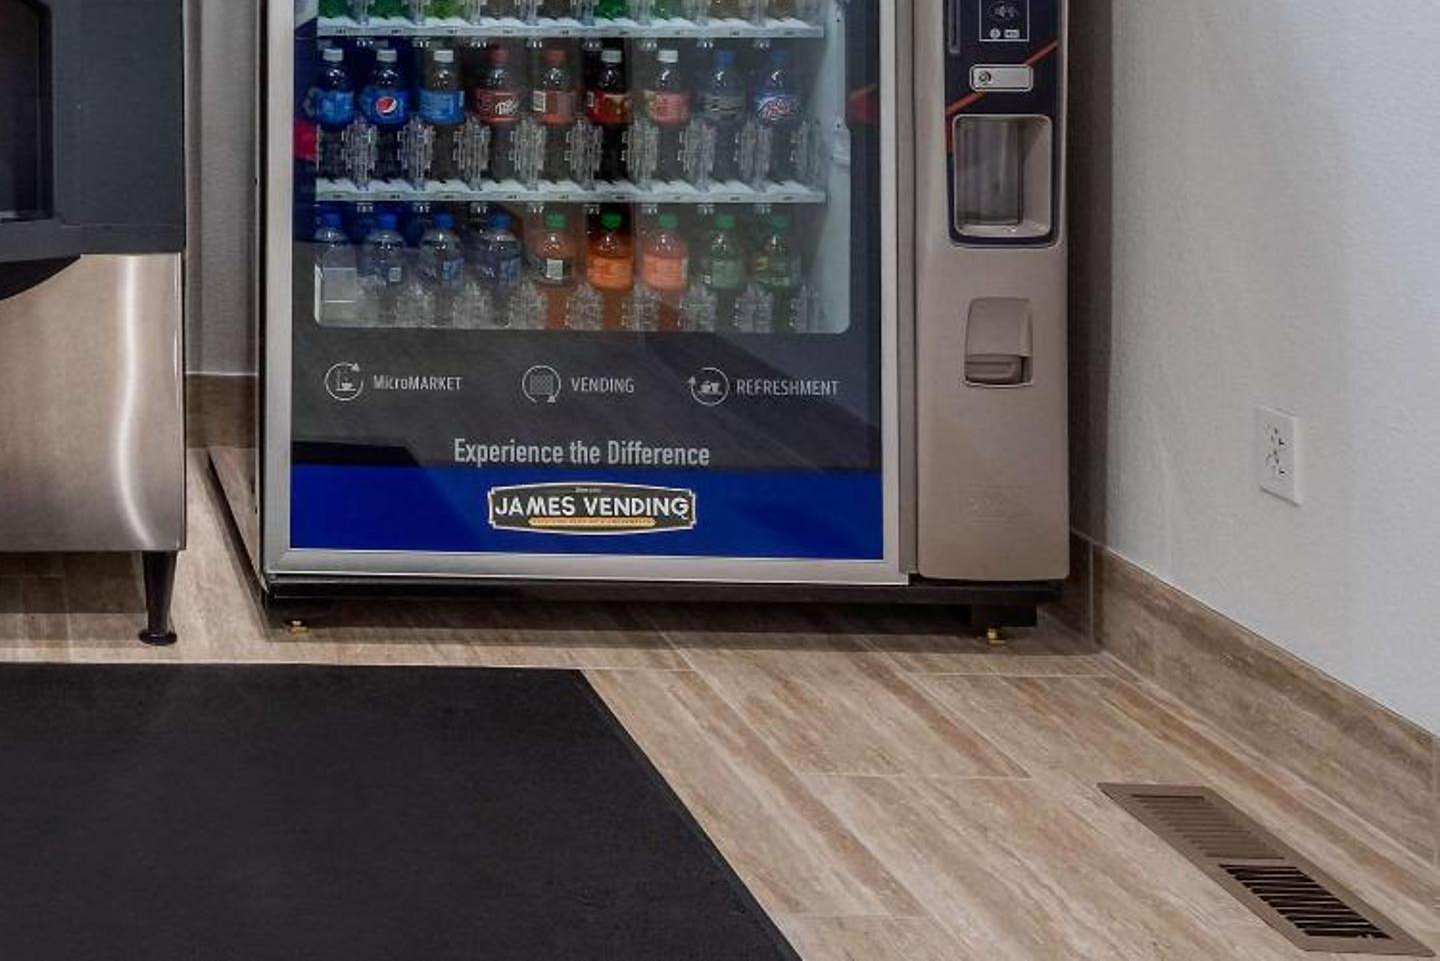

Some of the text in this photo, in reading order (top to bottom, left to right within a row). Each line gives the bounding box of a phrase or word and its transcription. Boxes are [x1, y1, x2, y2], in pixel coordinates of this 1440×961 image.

[373, 375, 463, 391] MicroMARKET
[571, 377, 635, 393] VENDING
[736, 379, 840, 396] REFRESHMENT
[454, 438, 710, 467] Experience the Difference
[495, 496, 690, 519] JAMES VENDING
